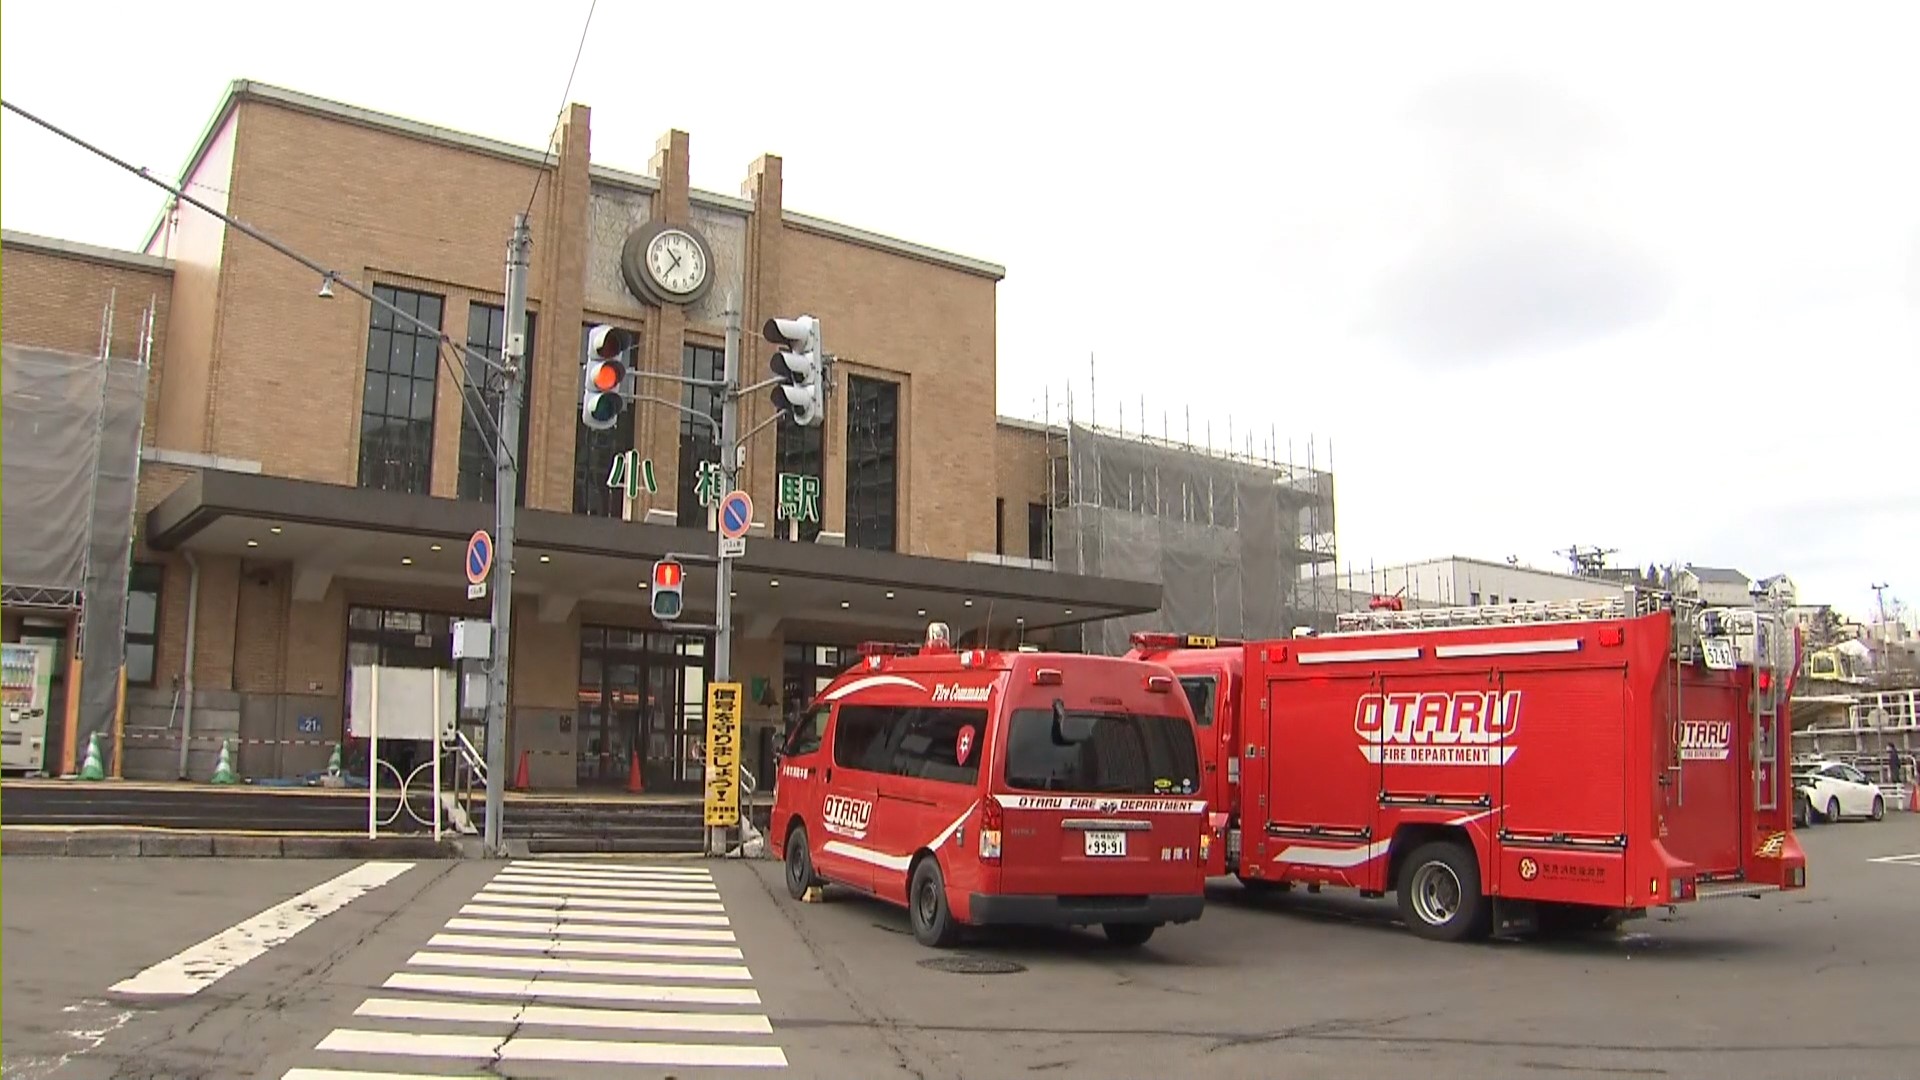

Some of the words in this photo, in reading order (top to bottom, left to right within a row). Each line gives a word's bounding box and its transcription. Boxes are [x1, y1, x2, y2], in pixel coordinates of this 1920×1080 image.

[932, 684, 950, 701] Fire
[949, 683, 993, 701] Command
[1354, 690, 1521, 744] OTARU
[1673, 721, 1730, 749] OTARU
[1383, 748, 1406, 761] FIRE
[1411, 748, 1489, 762] DEPARTMENT
[822, 795, 873, 831] OTARU
[1018, 797, 1063, 808] OTARU
[1069, 798, 1097, 808] FIRE
[1120, 800, 1194, 811] DEPARTMENT
